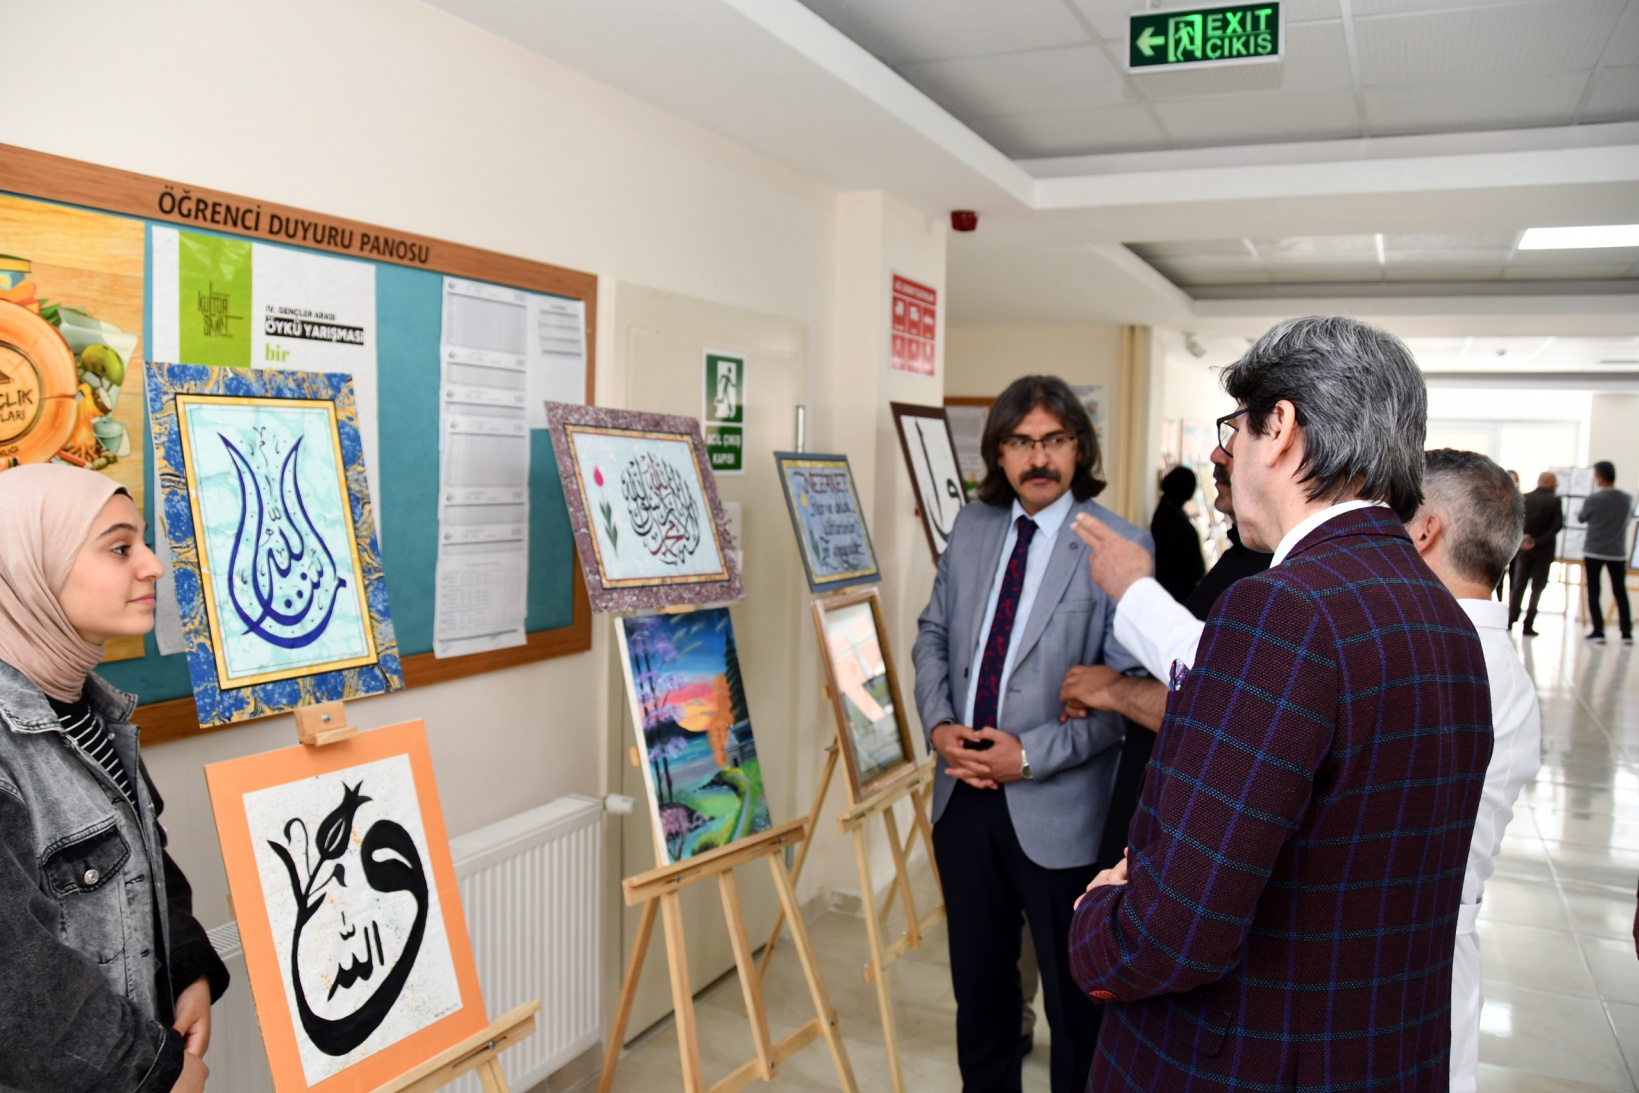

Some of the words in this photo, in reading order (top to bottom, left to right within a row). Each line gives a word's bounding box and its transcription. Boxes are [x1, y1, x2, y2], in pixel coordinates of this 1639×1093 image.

[1206, 8, 1273, 34] EXIT
[158, 184, 262, 232] ÖĞRENCİ
[268, 213, 354, 250] DUYURU
[359, 231, 430, 264] PANOSU
[314, 311, 336, 321] ARASI
[265, 316, 303, 338] ÖYKÜ
[302, 323, 364, 344] YARIŞMASI
[265, 343, 290, 363] bir
